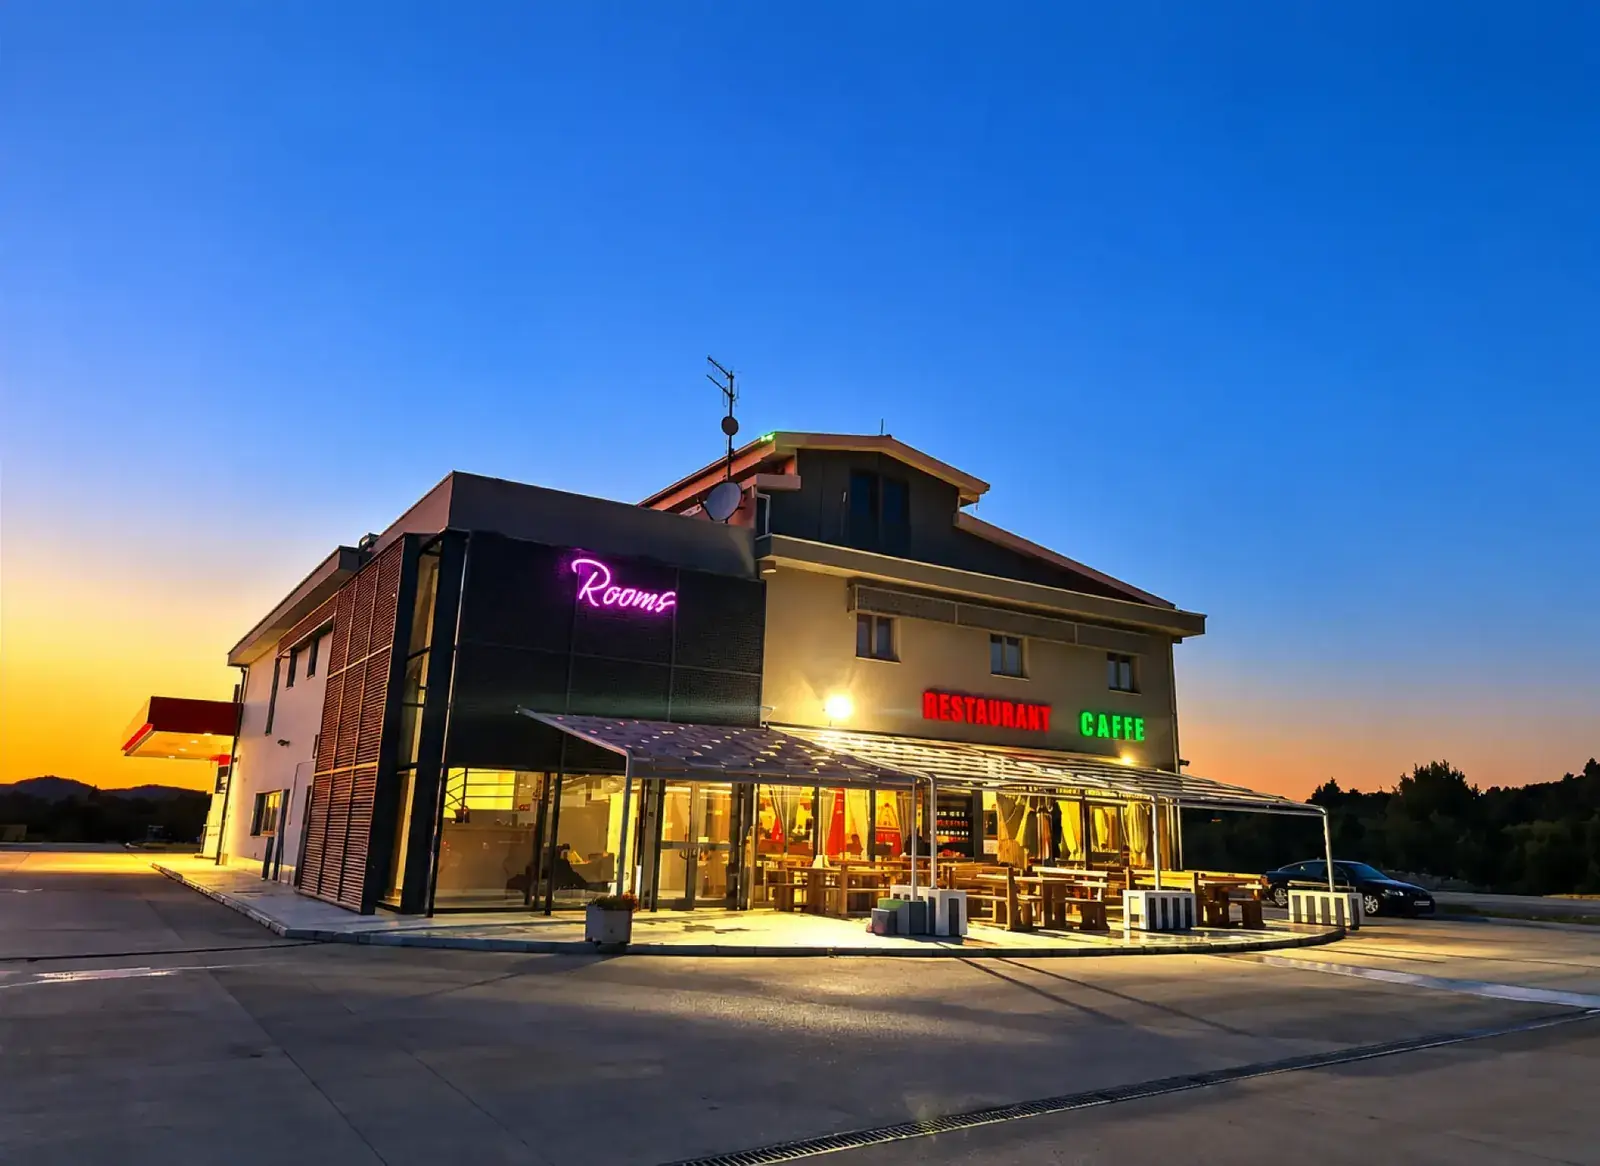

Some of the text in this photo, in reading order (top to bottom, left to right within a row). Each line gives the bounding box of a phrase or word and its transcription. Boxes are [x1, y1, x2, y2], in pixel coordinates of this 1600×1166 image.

[571, 558, 676, 612] Rooms
[922, 691, 1052, 733] RESTAURANT
[1080, 711, 1145, 742] CAFFE
